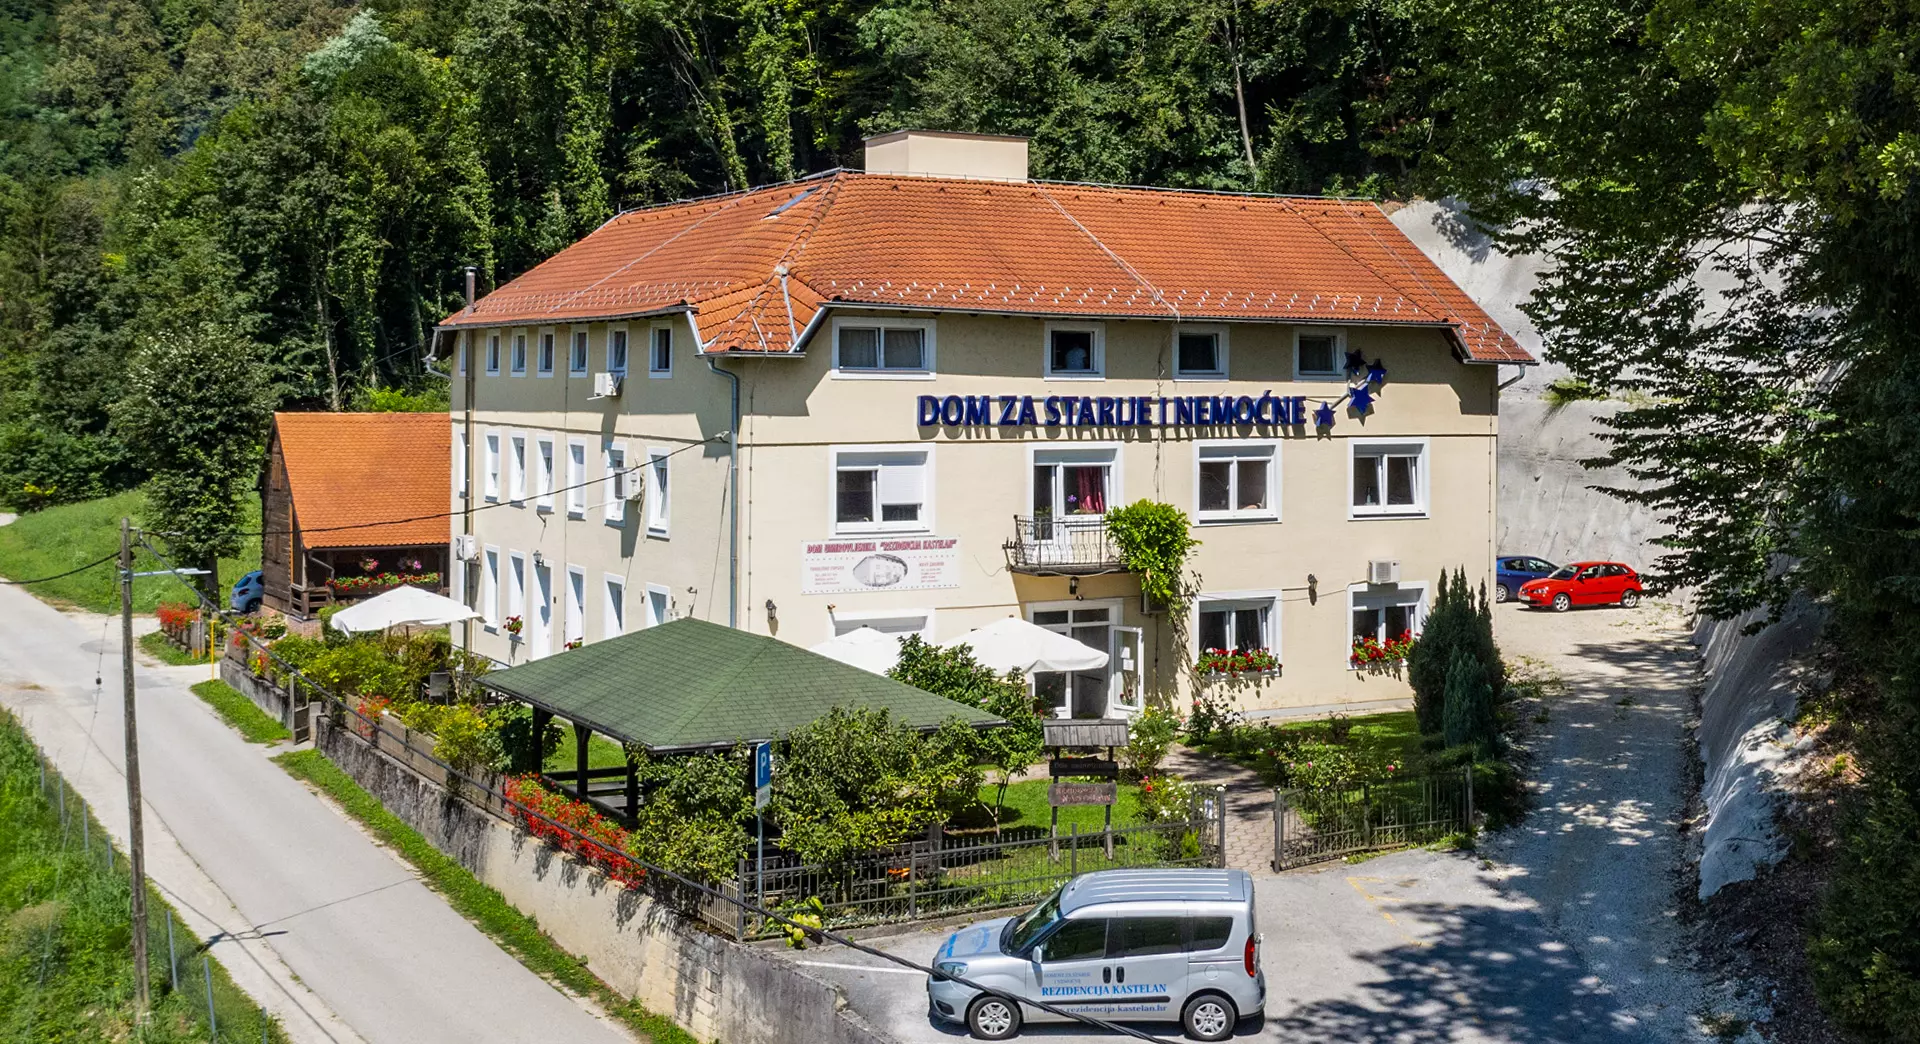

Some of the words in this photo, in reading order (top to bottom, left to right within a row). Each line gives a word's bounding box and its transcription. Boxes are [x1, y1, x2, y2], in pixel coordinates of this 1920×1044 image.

[917, 395, 991, 426] DOM
[998, 395, 1038, 426] ZA
[1044, 395, 1152, 426] STARIJE
[1159, 396, 1167, 425] I
[1173, 390, 1306, 425] NEMOĆNE
[760, 752, 767, 778] P
[1042, 985, 1109, 996] REZIDENCIJA
[1113, 984, 1166, 994] KASTELAN
